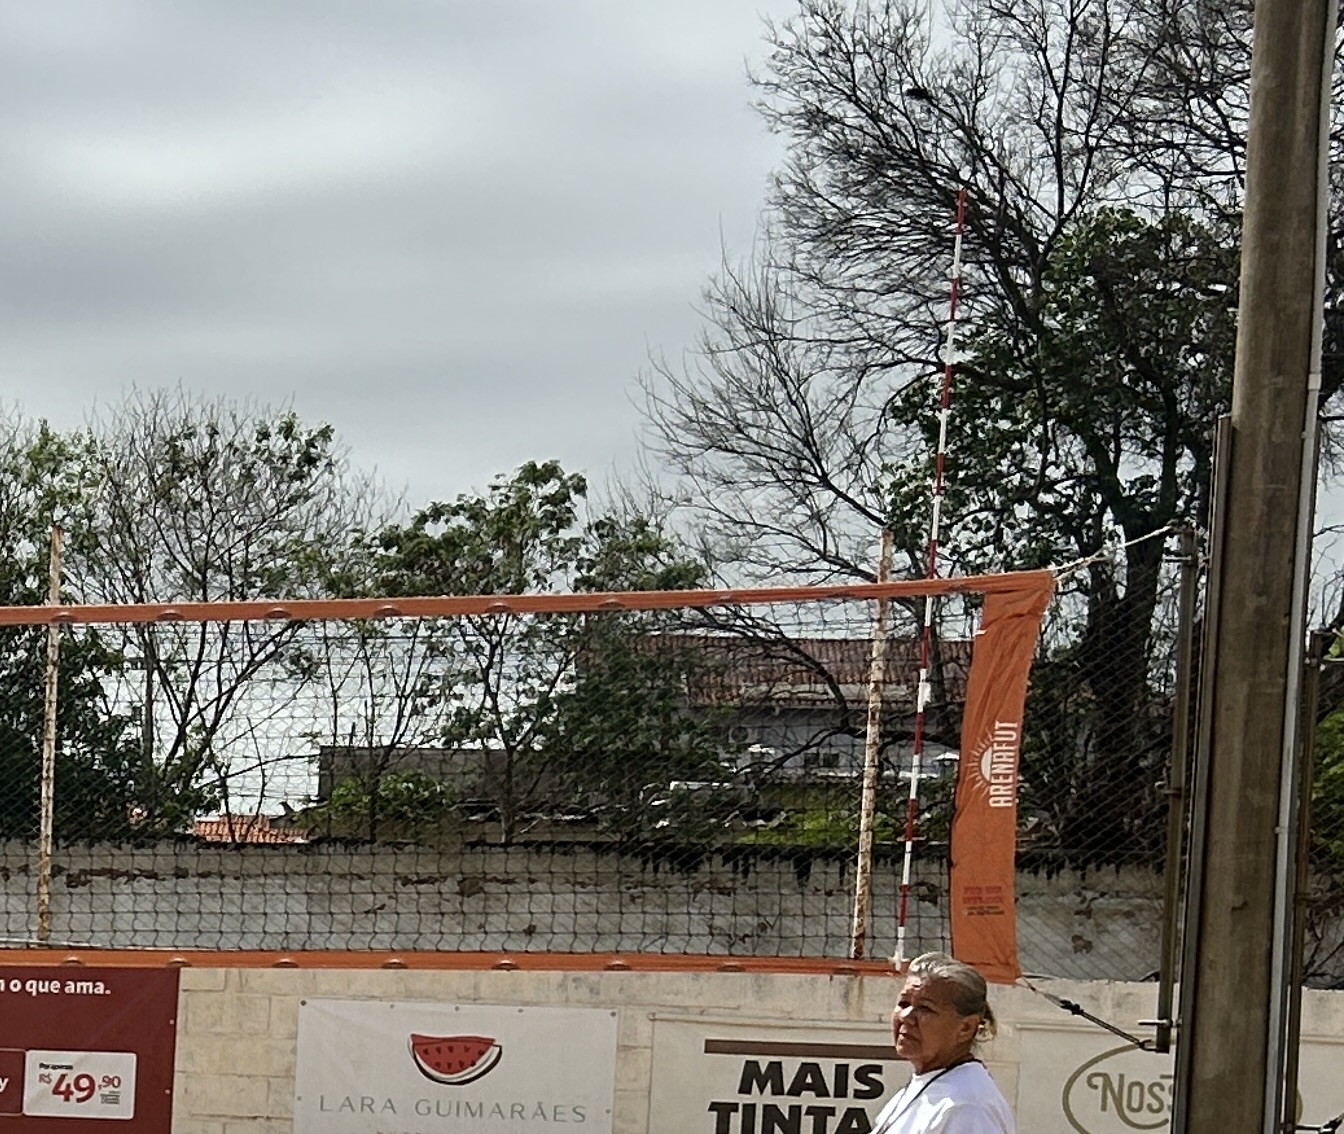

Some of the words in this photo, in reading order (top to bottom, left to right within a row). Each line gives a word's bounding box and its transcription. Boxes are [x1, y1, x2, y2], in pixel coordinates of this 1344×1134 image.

[988, 720, 1018, 807] ARENAFUT
[10, 980, 20, 992] o
[25, 981, 61, 997] que
[65, 982, 112, 996] ama.
[737, 1060, 885, 1100] MAIS
[320, 1095, 397, 1115] LARA
[415, 1098, 587, 1123] GUIMARÃES
